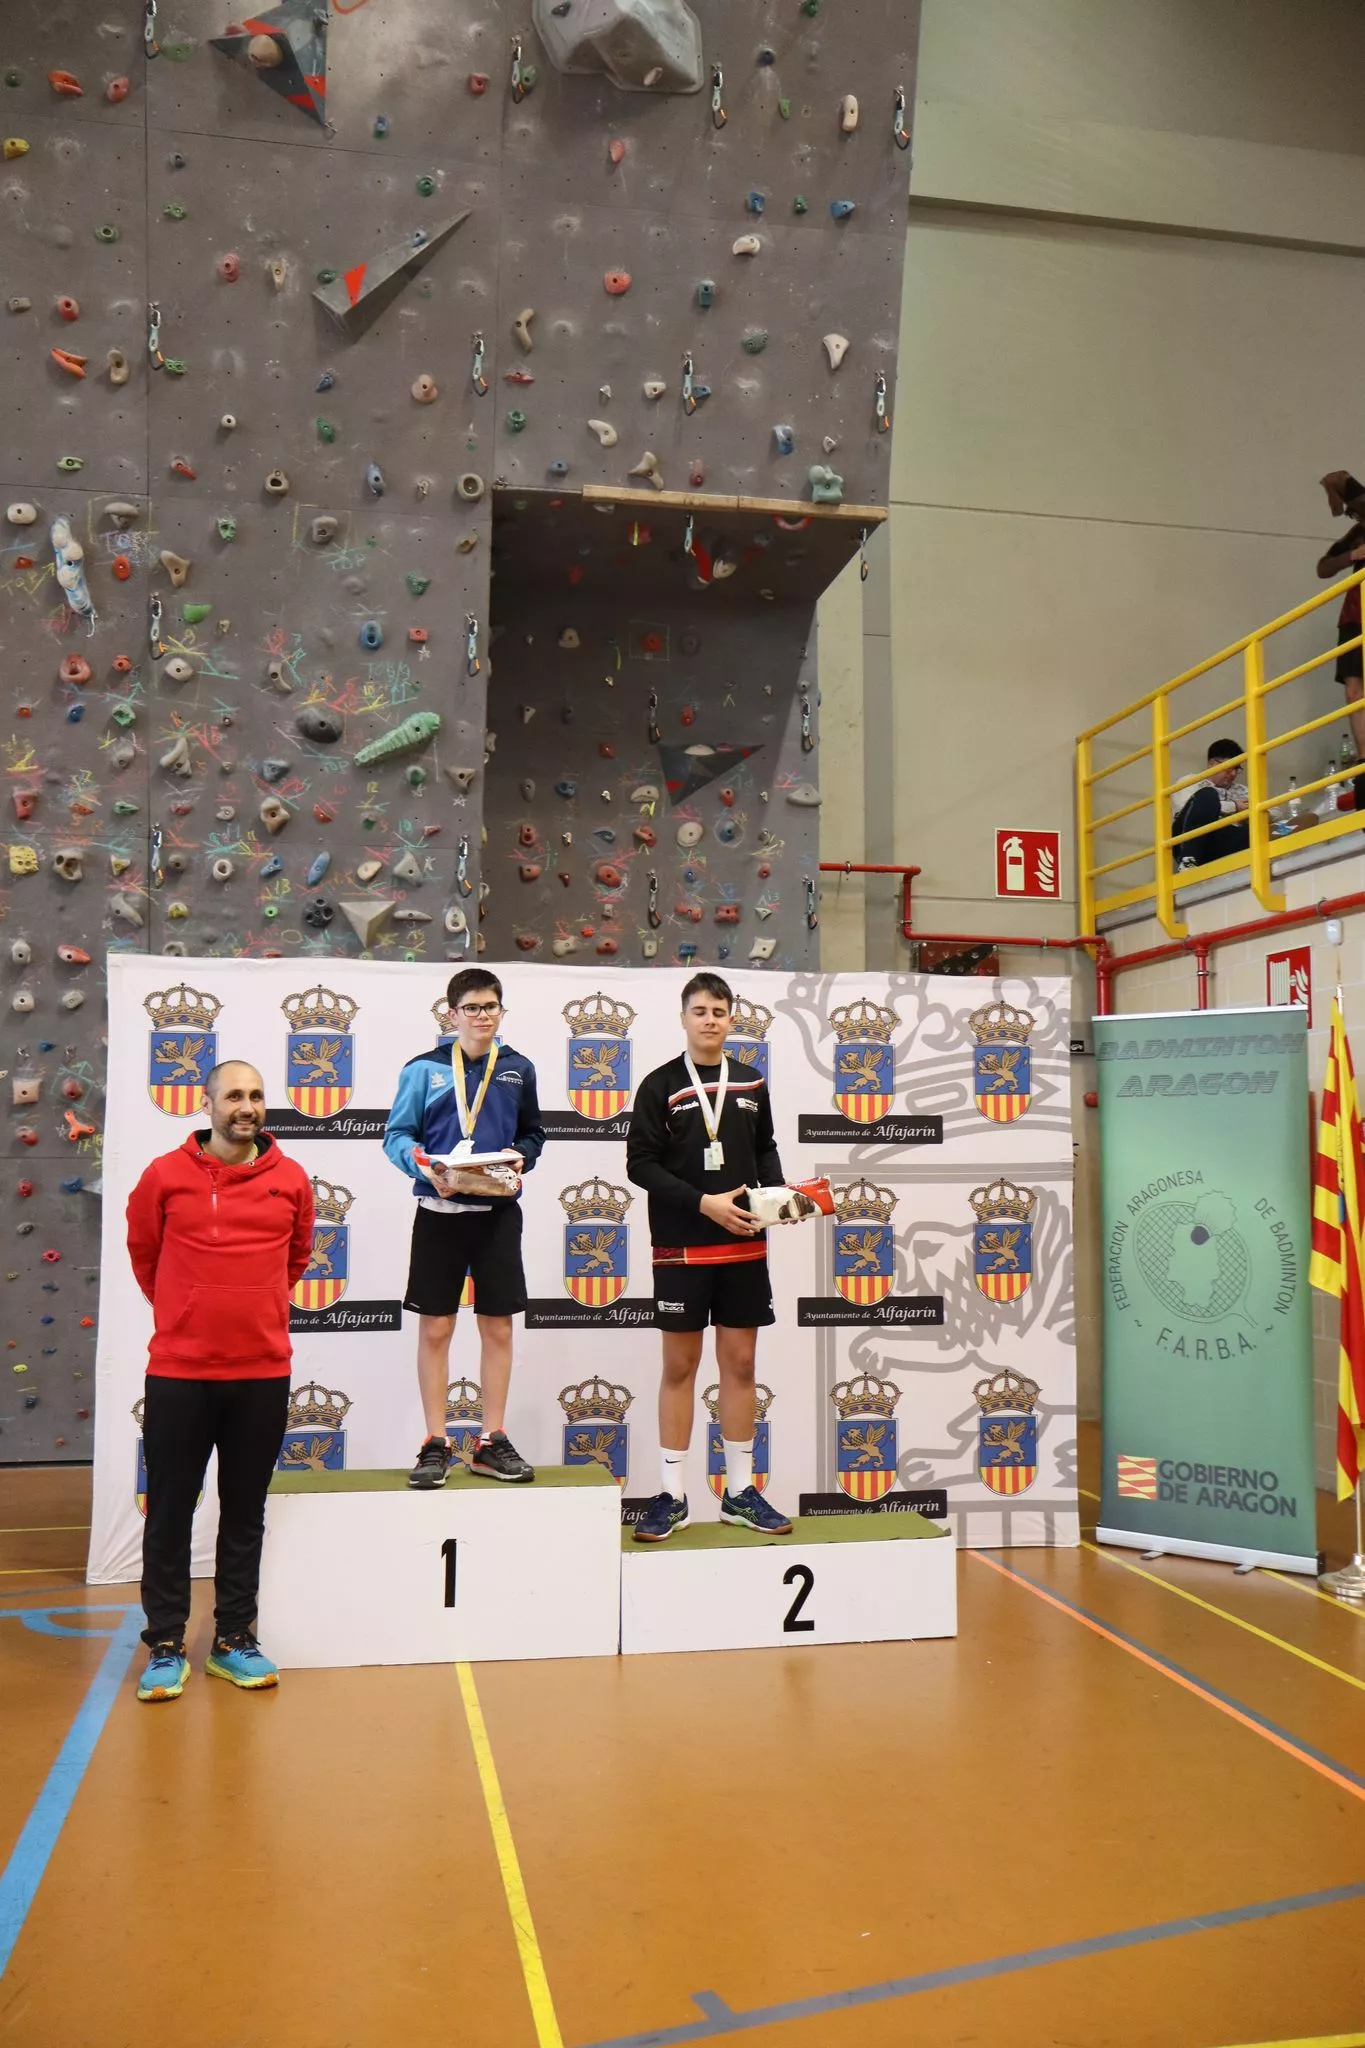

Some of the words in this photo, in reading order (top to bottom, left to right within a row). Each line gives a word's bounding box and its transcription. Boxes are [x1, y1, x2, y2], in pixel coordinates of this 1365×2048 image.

[1096, 1033, 1306, 1062] BADMINTON
[1117, 1071, 1279, 1097] ARAGON
[315, 1123, 326, 1132] de
[596, 1125, 606, 1133] de
[804, 1128, 860, 1138] Ayuntamiento
[861, 1128, 871, 1136] de
[873, 1123, 936, 1141] Alfajarín
[1108, 1220, 1131, 1312] FEDERACION
[1126, 1170, 1204, 1217] ARAGONESA
[1254, 1197, 1277, 1220] DE
[1269, 1221, 1297, 1316] BADMINTON
[309, 1316, 320, 1325] de
[323, 1310, 393, 1329] Alfajarín
[531, 1313, 591, 1324] Ayuntamiento
[592, 1312, 602, 1321] de
[804, 1312, 860, 1321] Ayuntamiento
[861, 1311, 871, 1319] de
[873, 1306, 937, 1323] Alfajarín
[1158, 1459, 1279, 1493] GOBIERNO
[1158, 1481, 1188, 1504] DE
[1195, 1486, 1297, 1518] ARAGON
[441, 1538, 458, 1608] 1
[782, 1564, 815, 1632] 2
